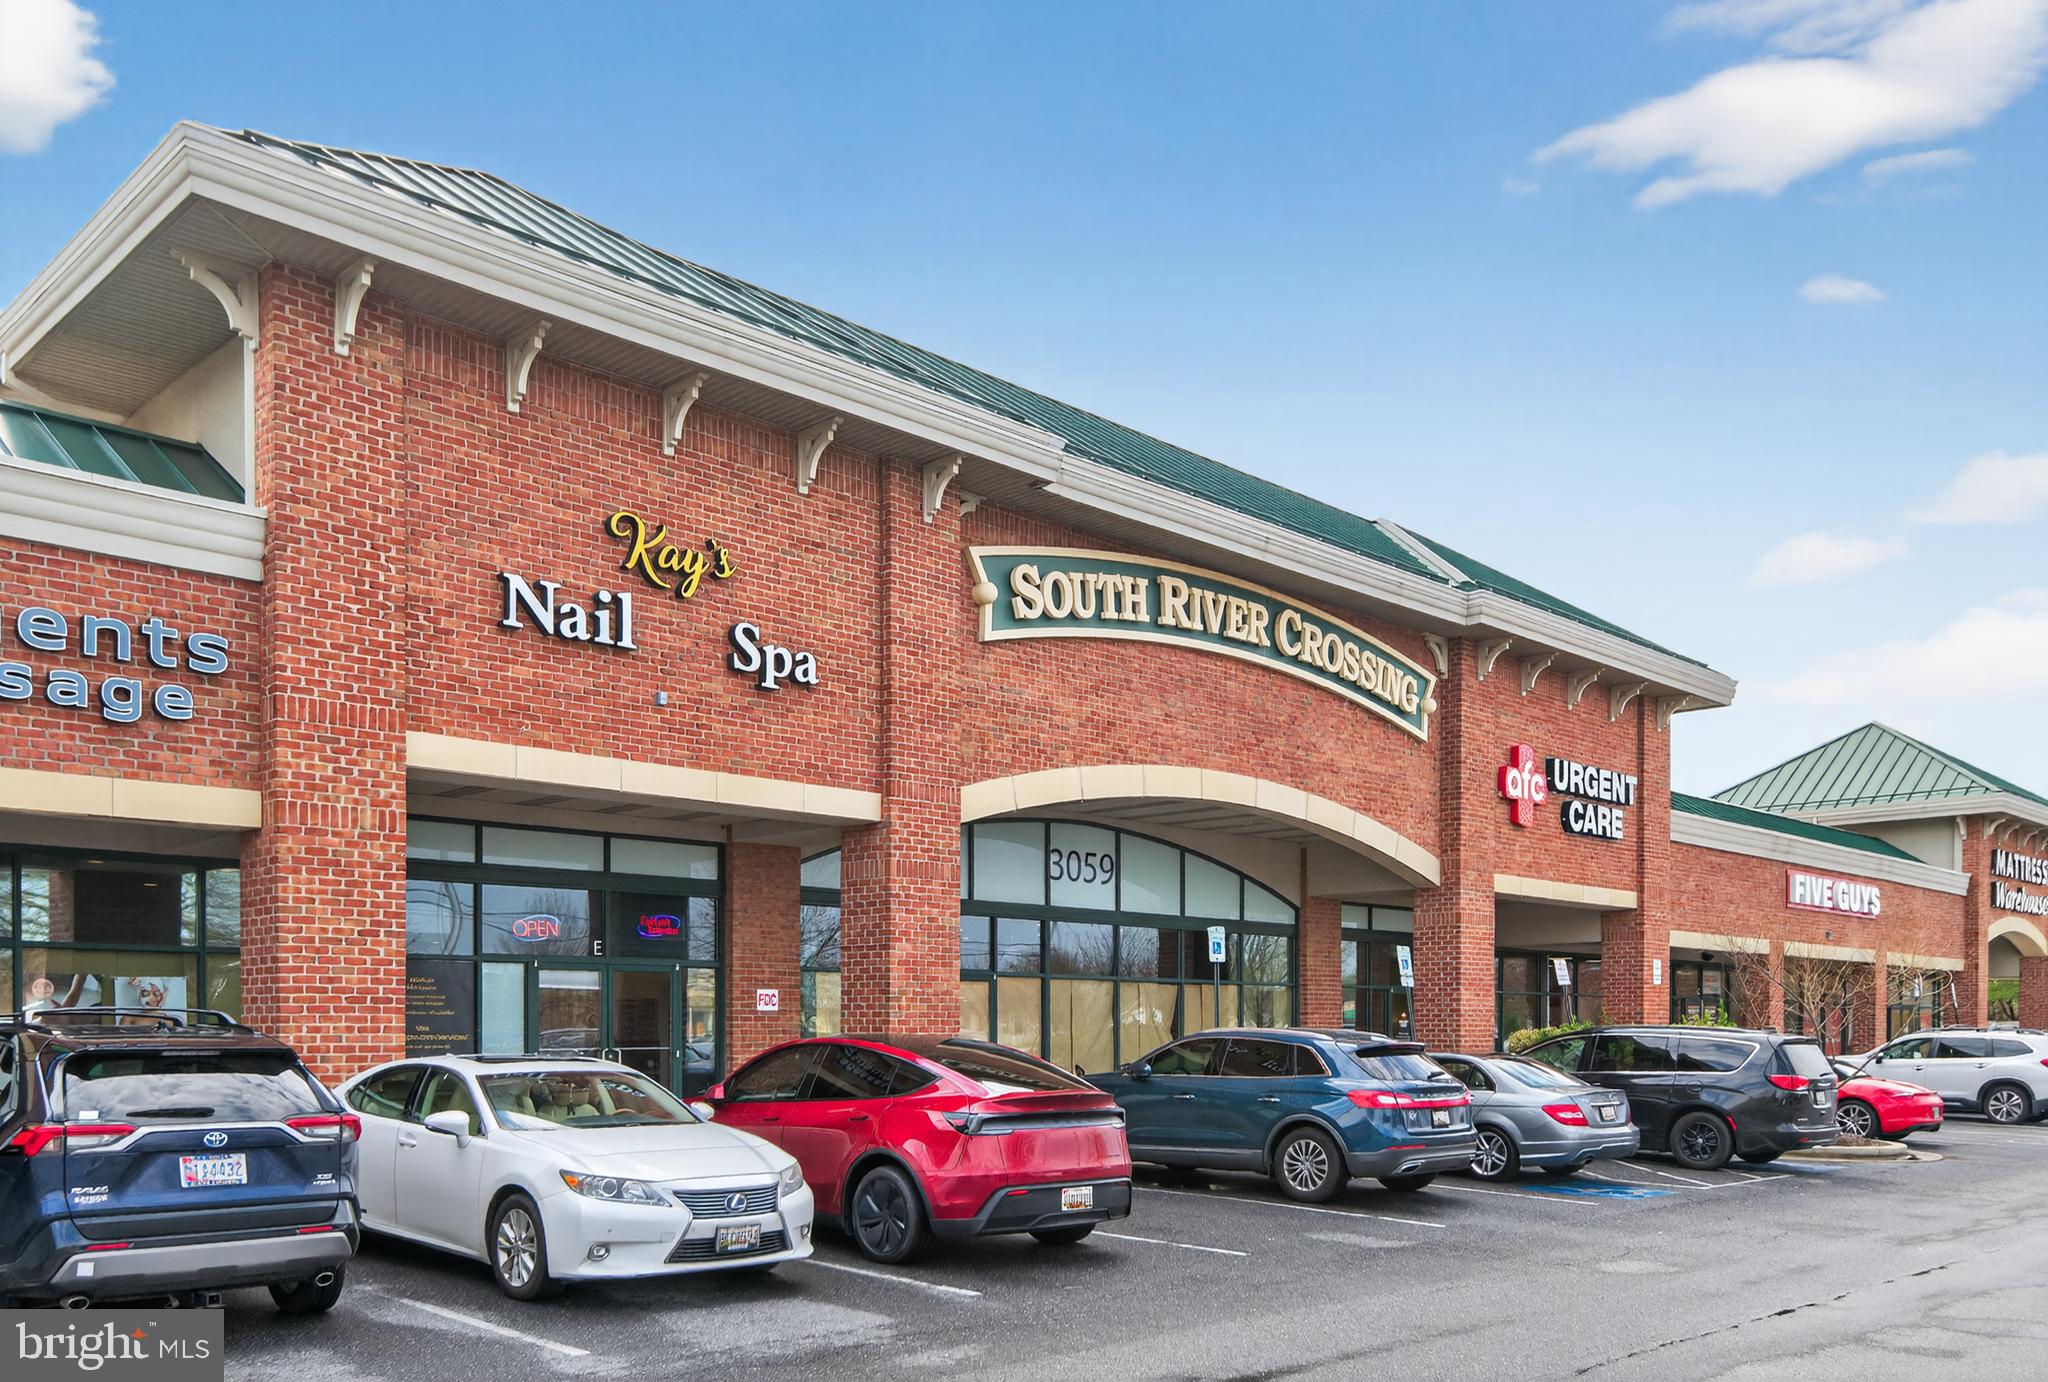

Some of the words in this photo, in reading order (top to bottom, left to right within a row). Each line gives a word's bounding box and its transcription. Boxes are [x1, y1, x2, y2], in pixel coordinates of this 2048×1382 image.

[607, 511, 738, 598] Kay's
[500, 572, 637, 649] Nail
[0, 606, 229, 674] ents
[731, 622, 819, 690] Spa
[1010, 563, 1150, 623] SOUTH
[1157, 575, 1270, 647] RIVER
[1274, 608, 1419, 715] CROSSING
[1507, 760, 1545, 801] afc
[1554, 758, 1637, 805] URGENT
[1569, 800, 1623, 839] CARE
[1049, 848, 1114, 885] 3059
[1794, 874, 1833, 908] FIVE
[1835, 881, 1880, 915] GUYS
[512, 919, 558, 937] OPEN
[594, 940, 602, 955] E
[758, 993, 777, 1007] FDC
